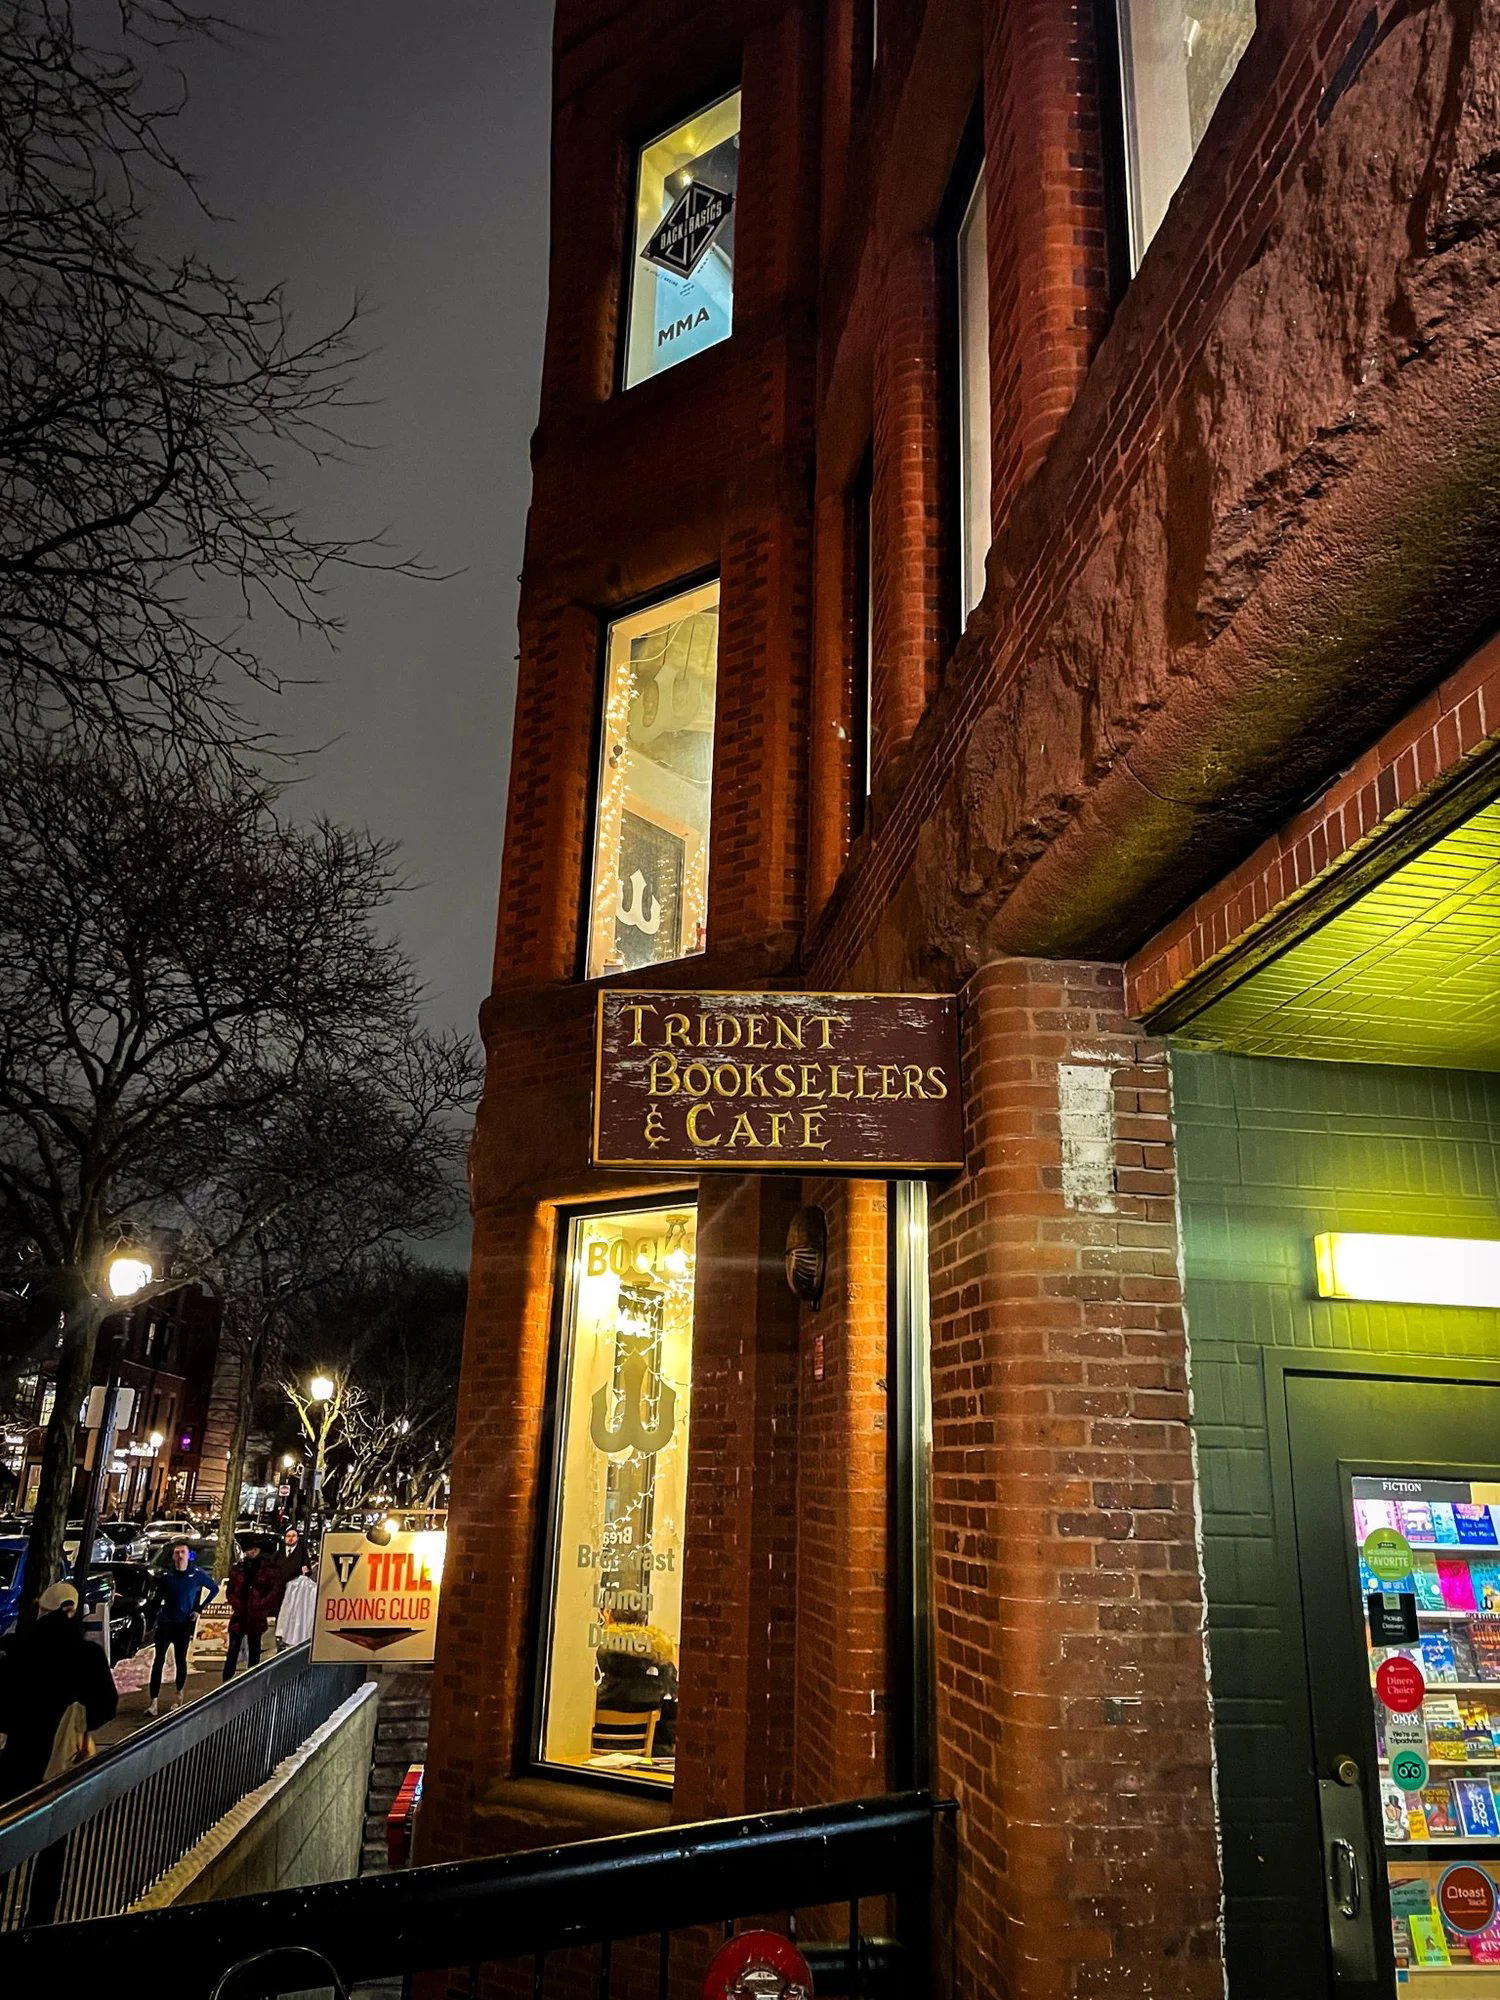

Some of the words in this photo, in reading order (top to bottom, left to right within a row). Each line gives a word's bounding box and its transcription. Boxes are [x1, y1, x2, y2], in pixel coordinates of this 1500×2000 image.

[688, 200, 723, 234] BASICS
[658, 307, 710, 347] MMA
[618, 1004, 846, 1050] TRIDENT
[648, 1051, 948, 1101] BOOKSELLERS
[644, 1103, 670, 1150] &
[685, 1102, 832, 1151] CAFÉ
[1382, 1482, 1422, 1492] FICTION
[577, 1544, 675, 1572] Brefast
[1368, 1556, 1410, 1567] FAVORITE
[367, 1553, 432, 1592] TITLE
[325, 1598, 386, 1621] BOXING
[389, 1597, 431, 1620] CLUB
[592, 1584, 654, 1612] Lunch
[588, 1623, 653, 1653] Dinner
[1387, 1686, 1415, 1695] Choice
[1391, 1713, 1420, 1726] ONYX
[1389, 1737, 1423, 1745] Tripadvisor
[1458, 1887, 1486, 1899] toast
